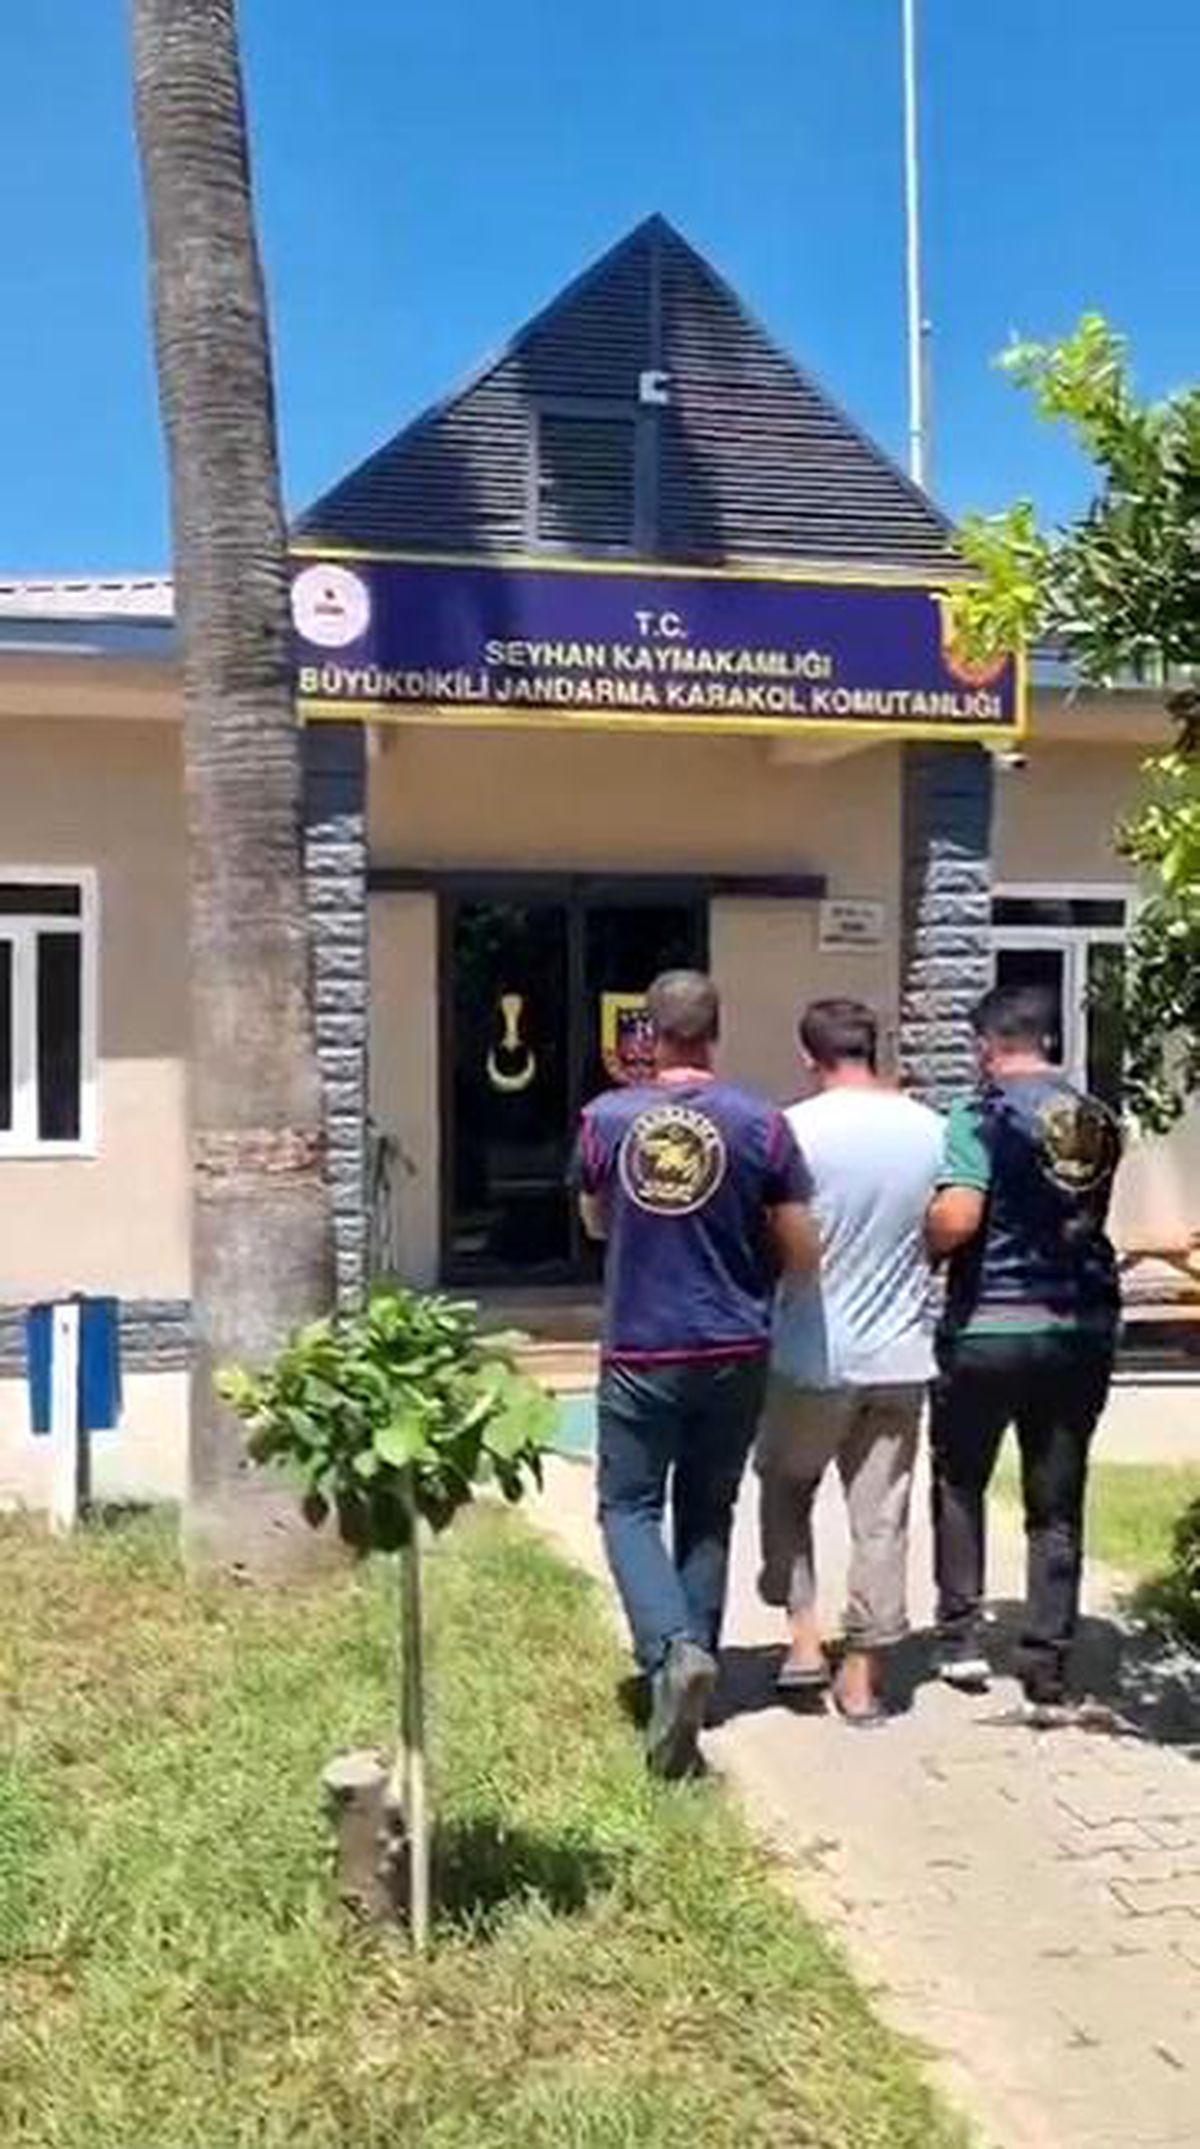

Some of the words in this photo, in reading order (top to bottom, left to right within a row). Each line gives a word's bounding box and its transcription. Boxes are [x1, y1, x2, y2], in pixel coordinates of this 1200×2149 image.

[635, 610, 687, 637] T.C.
[484, 641, 604, 668] SEYHAN
[612, 644, 831, 679] KAYMAKAMLIĞI
[300, 663, 488, 698] BÜYÜKDİKİLİ
[496, 677, 657, 706] JANDARMA
[666, 682, 804, 712] KARAKOL
[812, 688, 1000, 718] KOMUTANLIĞI
